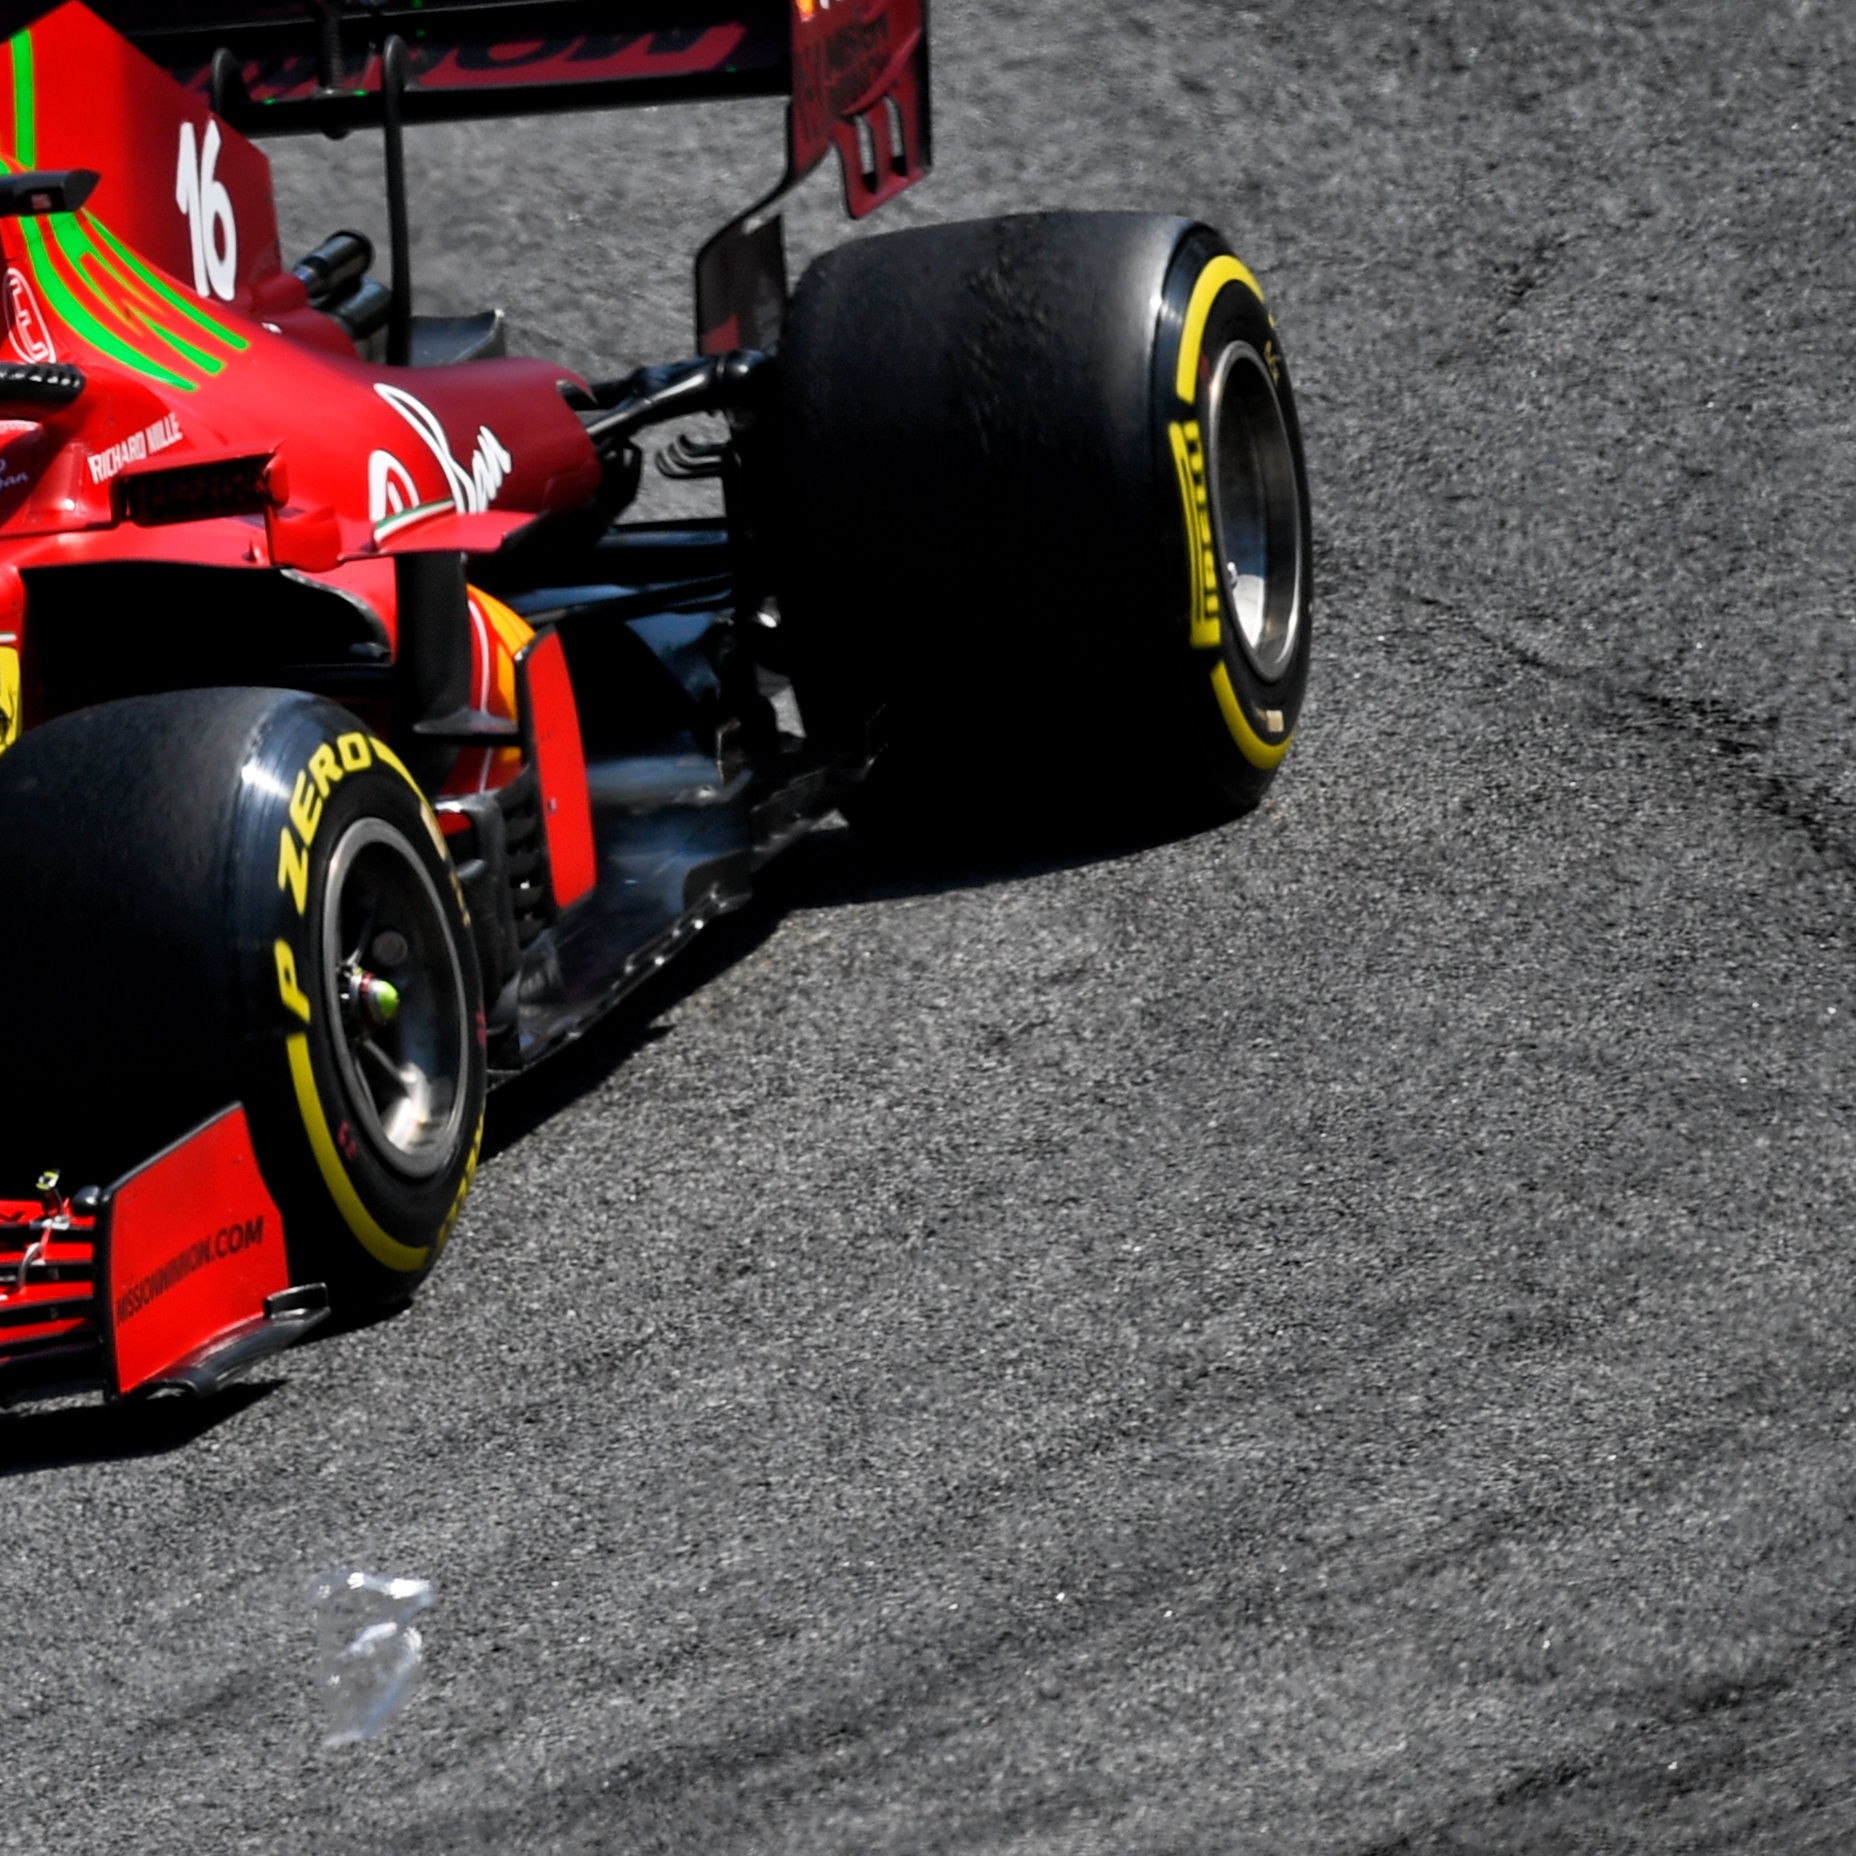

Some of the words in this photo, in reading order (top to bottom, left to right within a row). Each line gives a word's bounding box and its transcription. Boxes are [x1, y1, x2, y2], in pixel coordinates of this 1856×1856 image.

[176, 119, 238, 301] 16
[88, 432, 147, 485] RICHARD
[277, 731, 373, 915] ZERO
